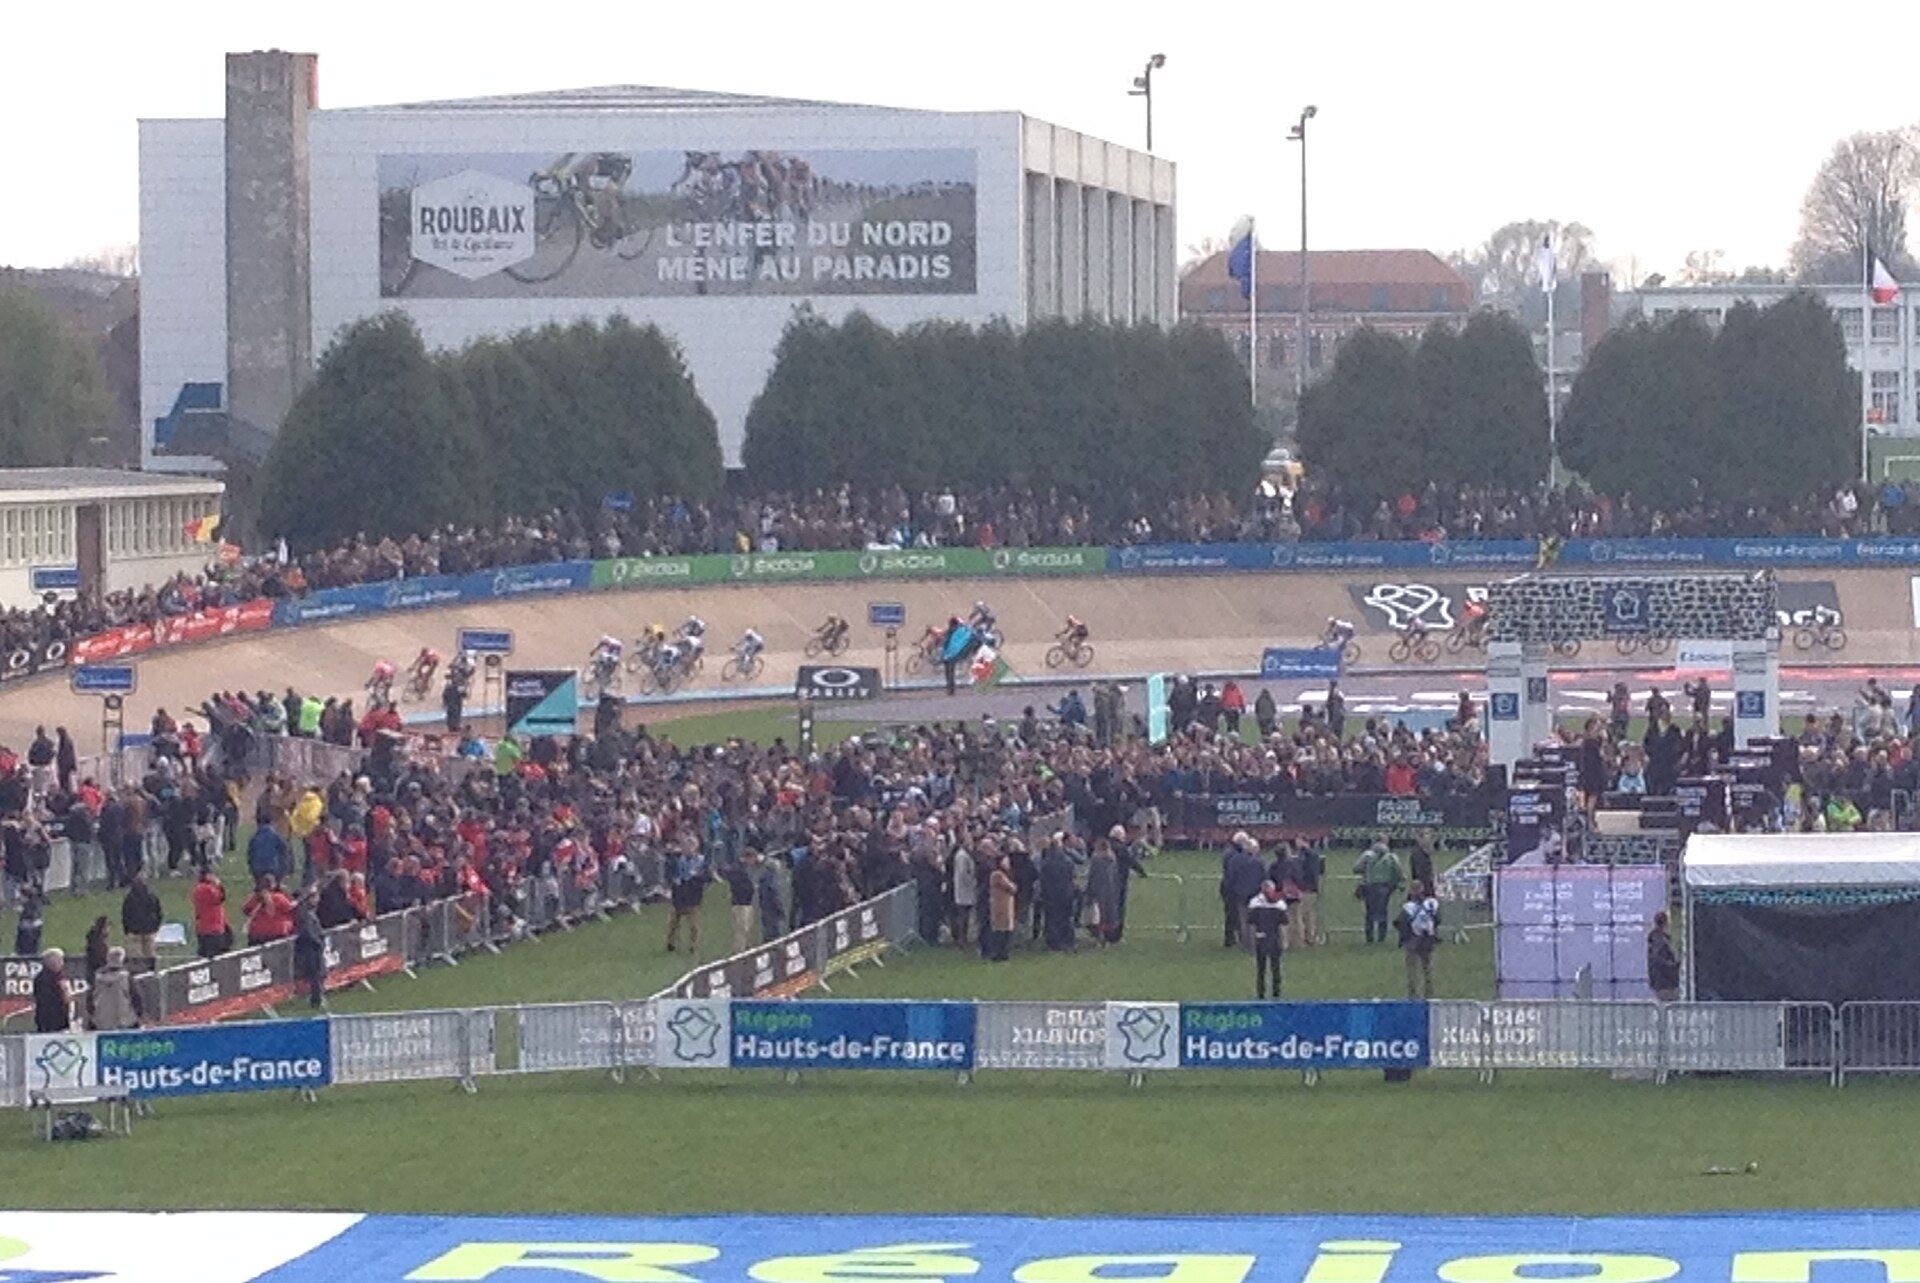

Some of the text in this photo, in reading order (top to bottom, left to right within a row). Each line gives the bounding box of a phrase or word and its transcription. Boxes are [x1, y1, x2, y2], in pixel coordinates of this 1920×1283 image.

[420, 205, 525, 234] ROUBAIX
[666, 221, 951, 246] L'ENFER DU NORD
[657, 250, 951, 281] MÈNE AU PARADIS
[736, 1035, 966, 1060] Hauts-de-France
[1187, 1034, 1420, 1059] Hauts-de-France
[103, 1058, 323, 1090] Hauts-de-France
